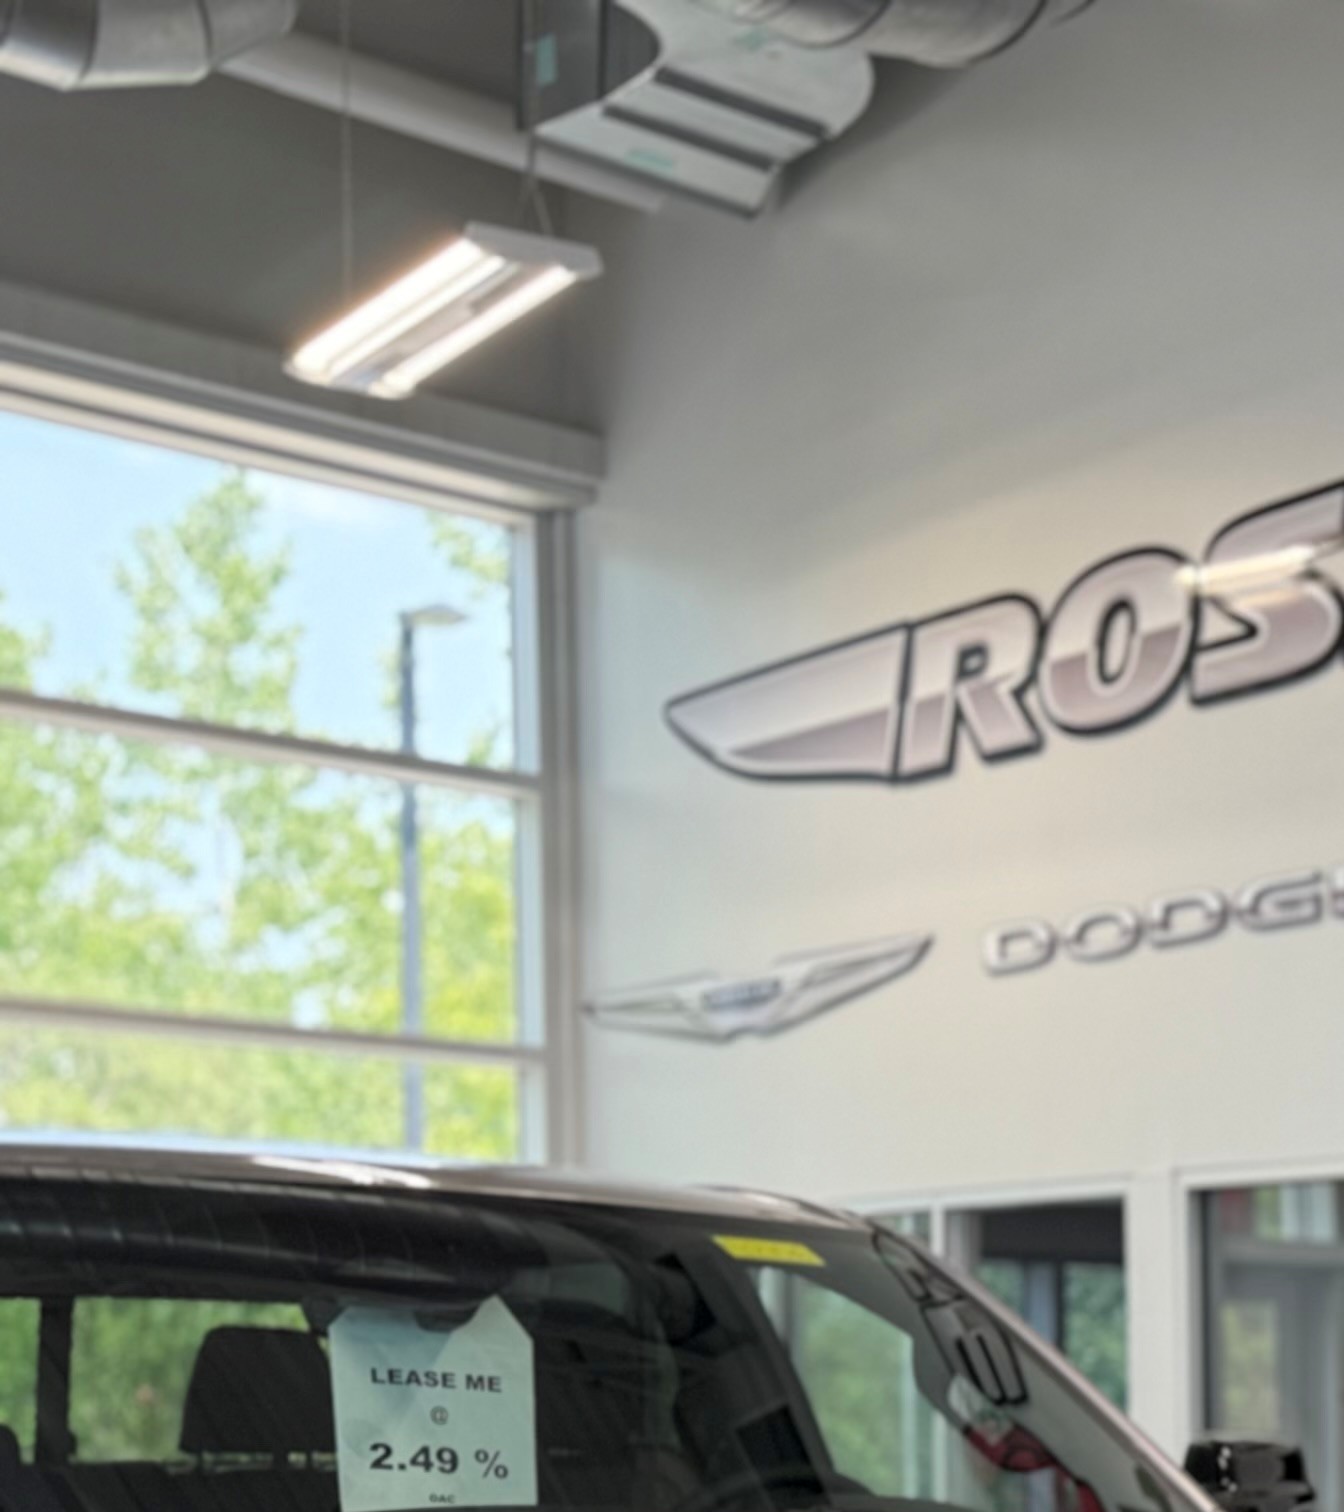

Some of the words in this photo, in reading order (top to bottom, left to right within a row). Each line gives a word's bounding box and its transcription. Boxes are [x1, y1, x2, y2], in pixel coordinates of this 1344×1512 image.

[370, 1367, 456, 1389] LEASE
[465, 1373, 503, 1393] ME
[369, 1442, 460, 1474] 2.49
[474, 1448, 509, 1480] %
